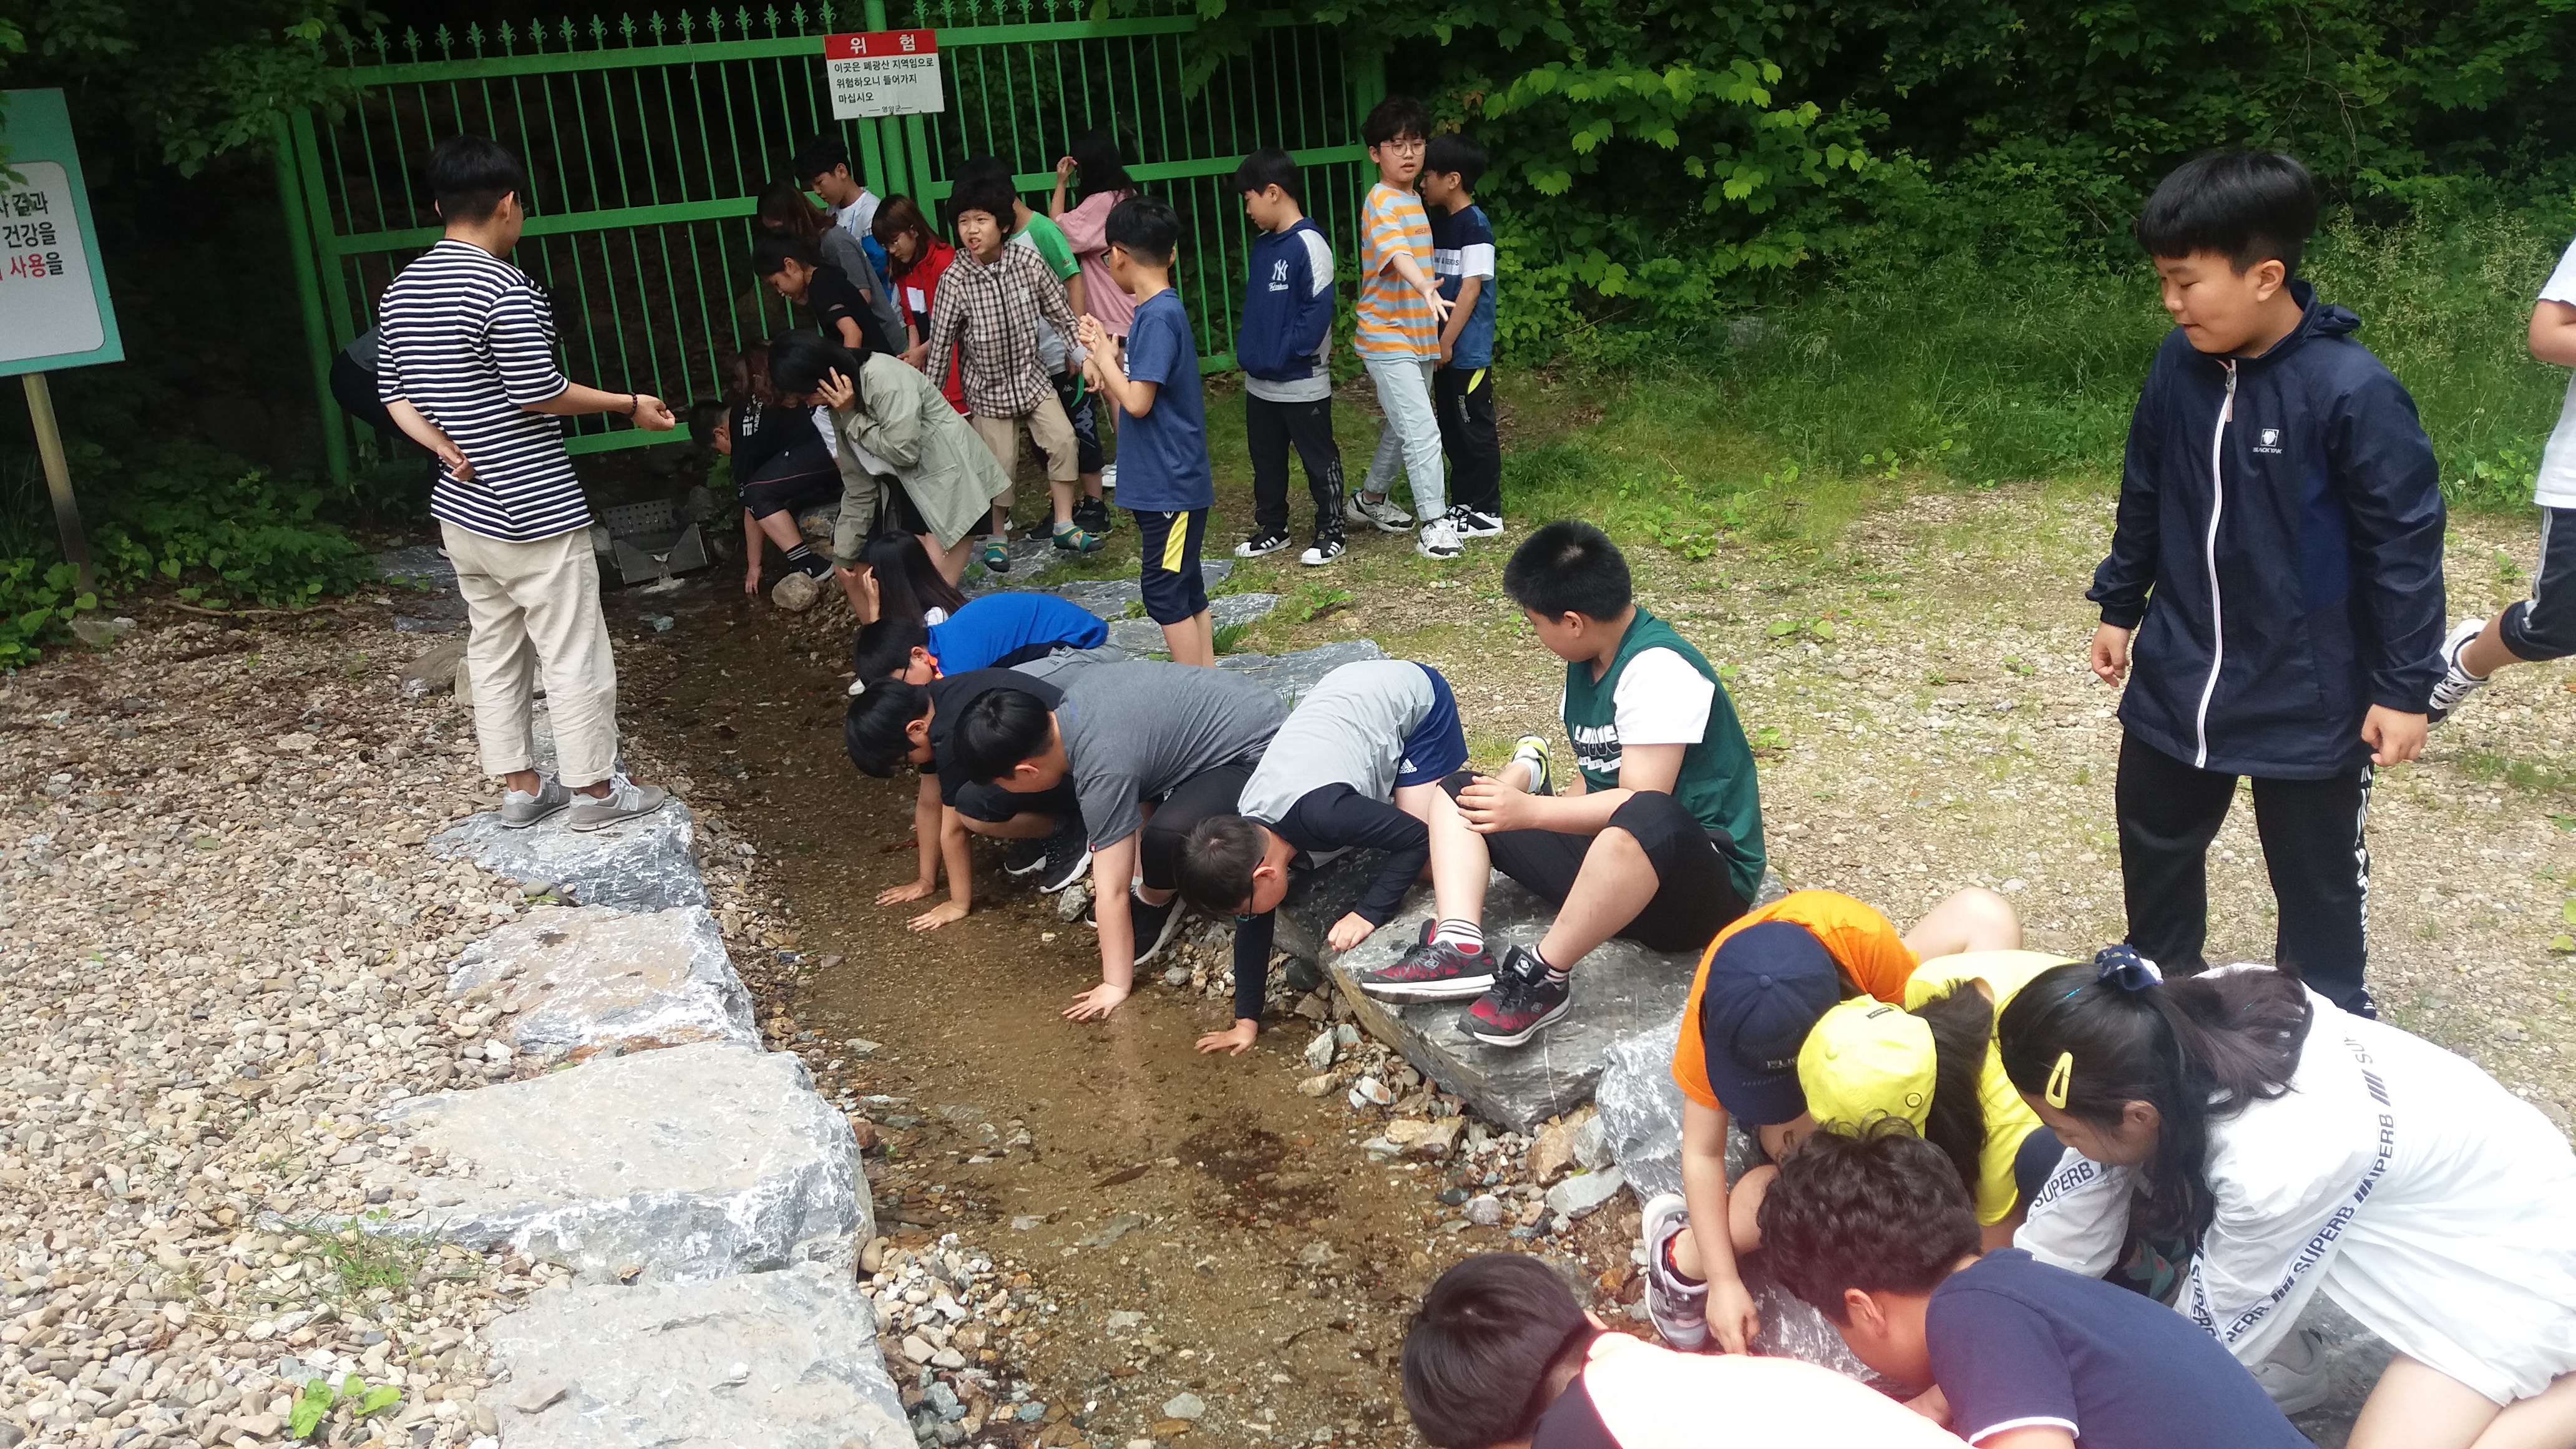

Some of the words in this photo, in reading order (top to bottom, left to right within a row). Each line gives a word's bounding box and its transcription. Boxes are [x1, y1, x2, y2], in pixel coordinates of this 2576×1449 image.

[834, 62, 861, 73] 이곳은
[892, 57, 934, 69] 지역임으로
[837, 76, 881, 89] 위험하오니
[883, 73, 917, 85] 들어가지
[838, 92, 874, 104] 마십시오
[2, 222, 57, 248] 건강을
[11, 251, 64, 278] 사용을
[2034, 1161, 2095, 1208] SUPERB
[2293, 1206, 2355, 1274] SUPERB
